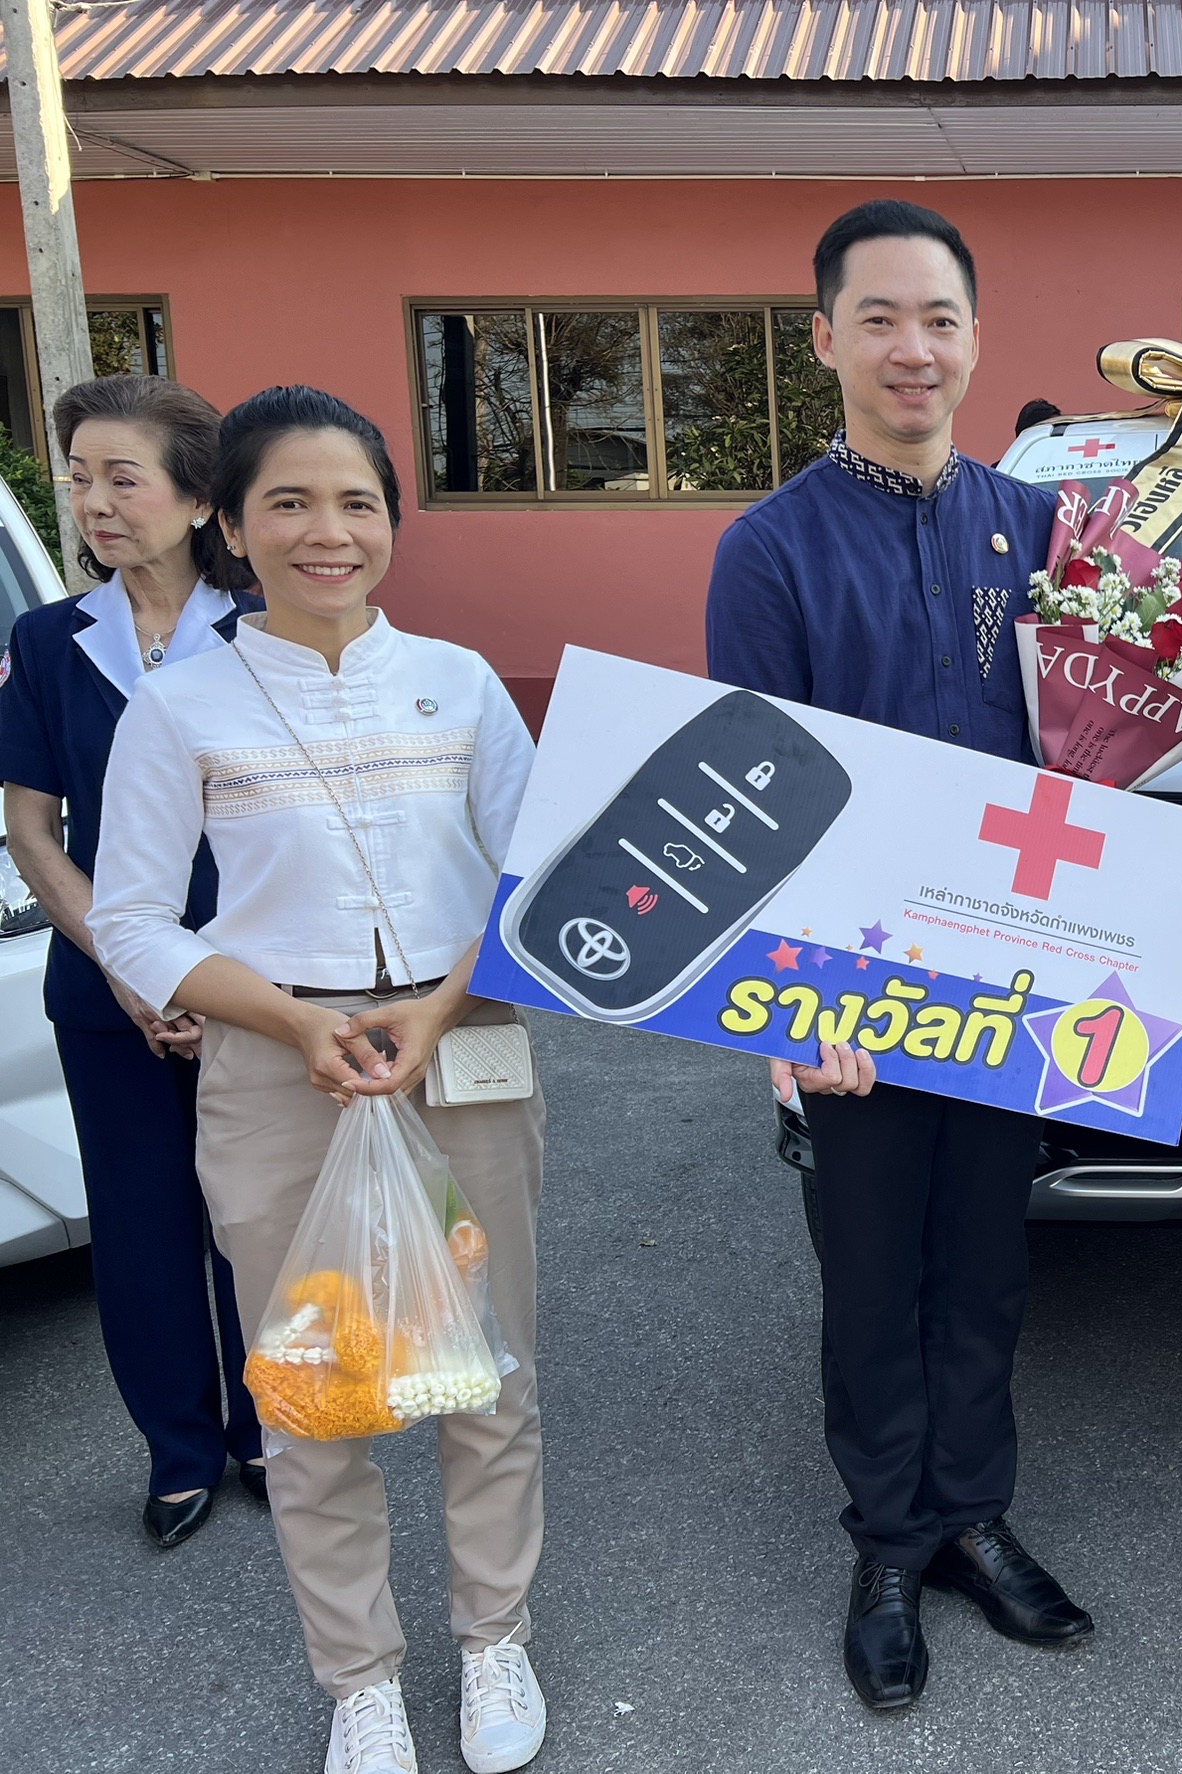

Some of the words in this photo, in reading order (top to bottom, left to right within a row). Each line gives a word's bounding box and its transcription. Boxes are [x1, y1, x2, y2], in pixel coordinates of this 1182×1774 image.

[904, 908, 990, 939] Kamphaengphet
[993, 929, 1038, 950] Province
[1042, 941, 1063, 956] Red
[1066, 946, 1096, 962] Cross
[1099, 954, 1140, 974] Chapter
[918, 884, 1136, 947] เหล่ากาชาดจังหวัดกำแพงเพชร
[718, 968, 1036, 1071] รางวัลที่
[1070, 1004, 1126, 1088] 1
